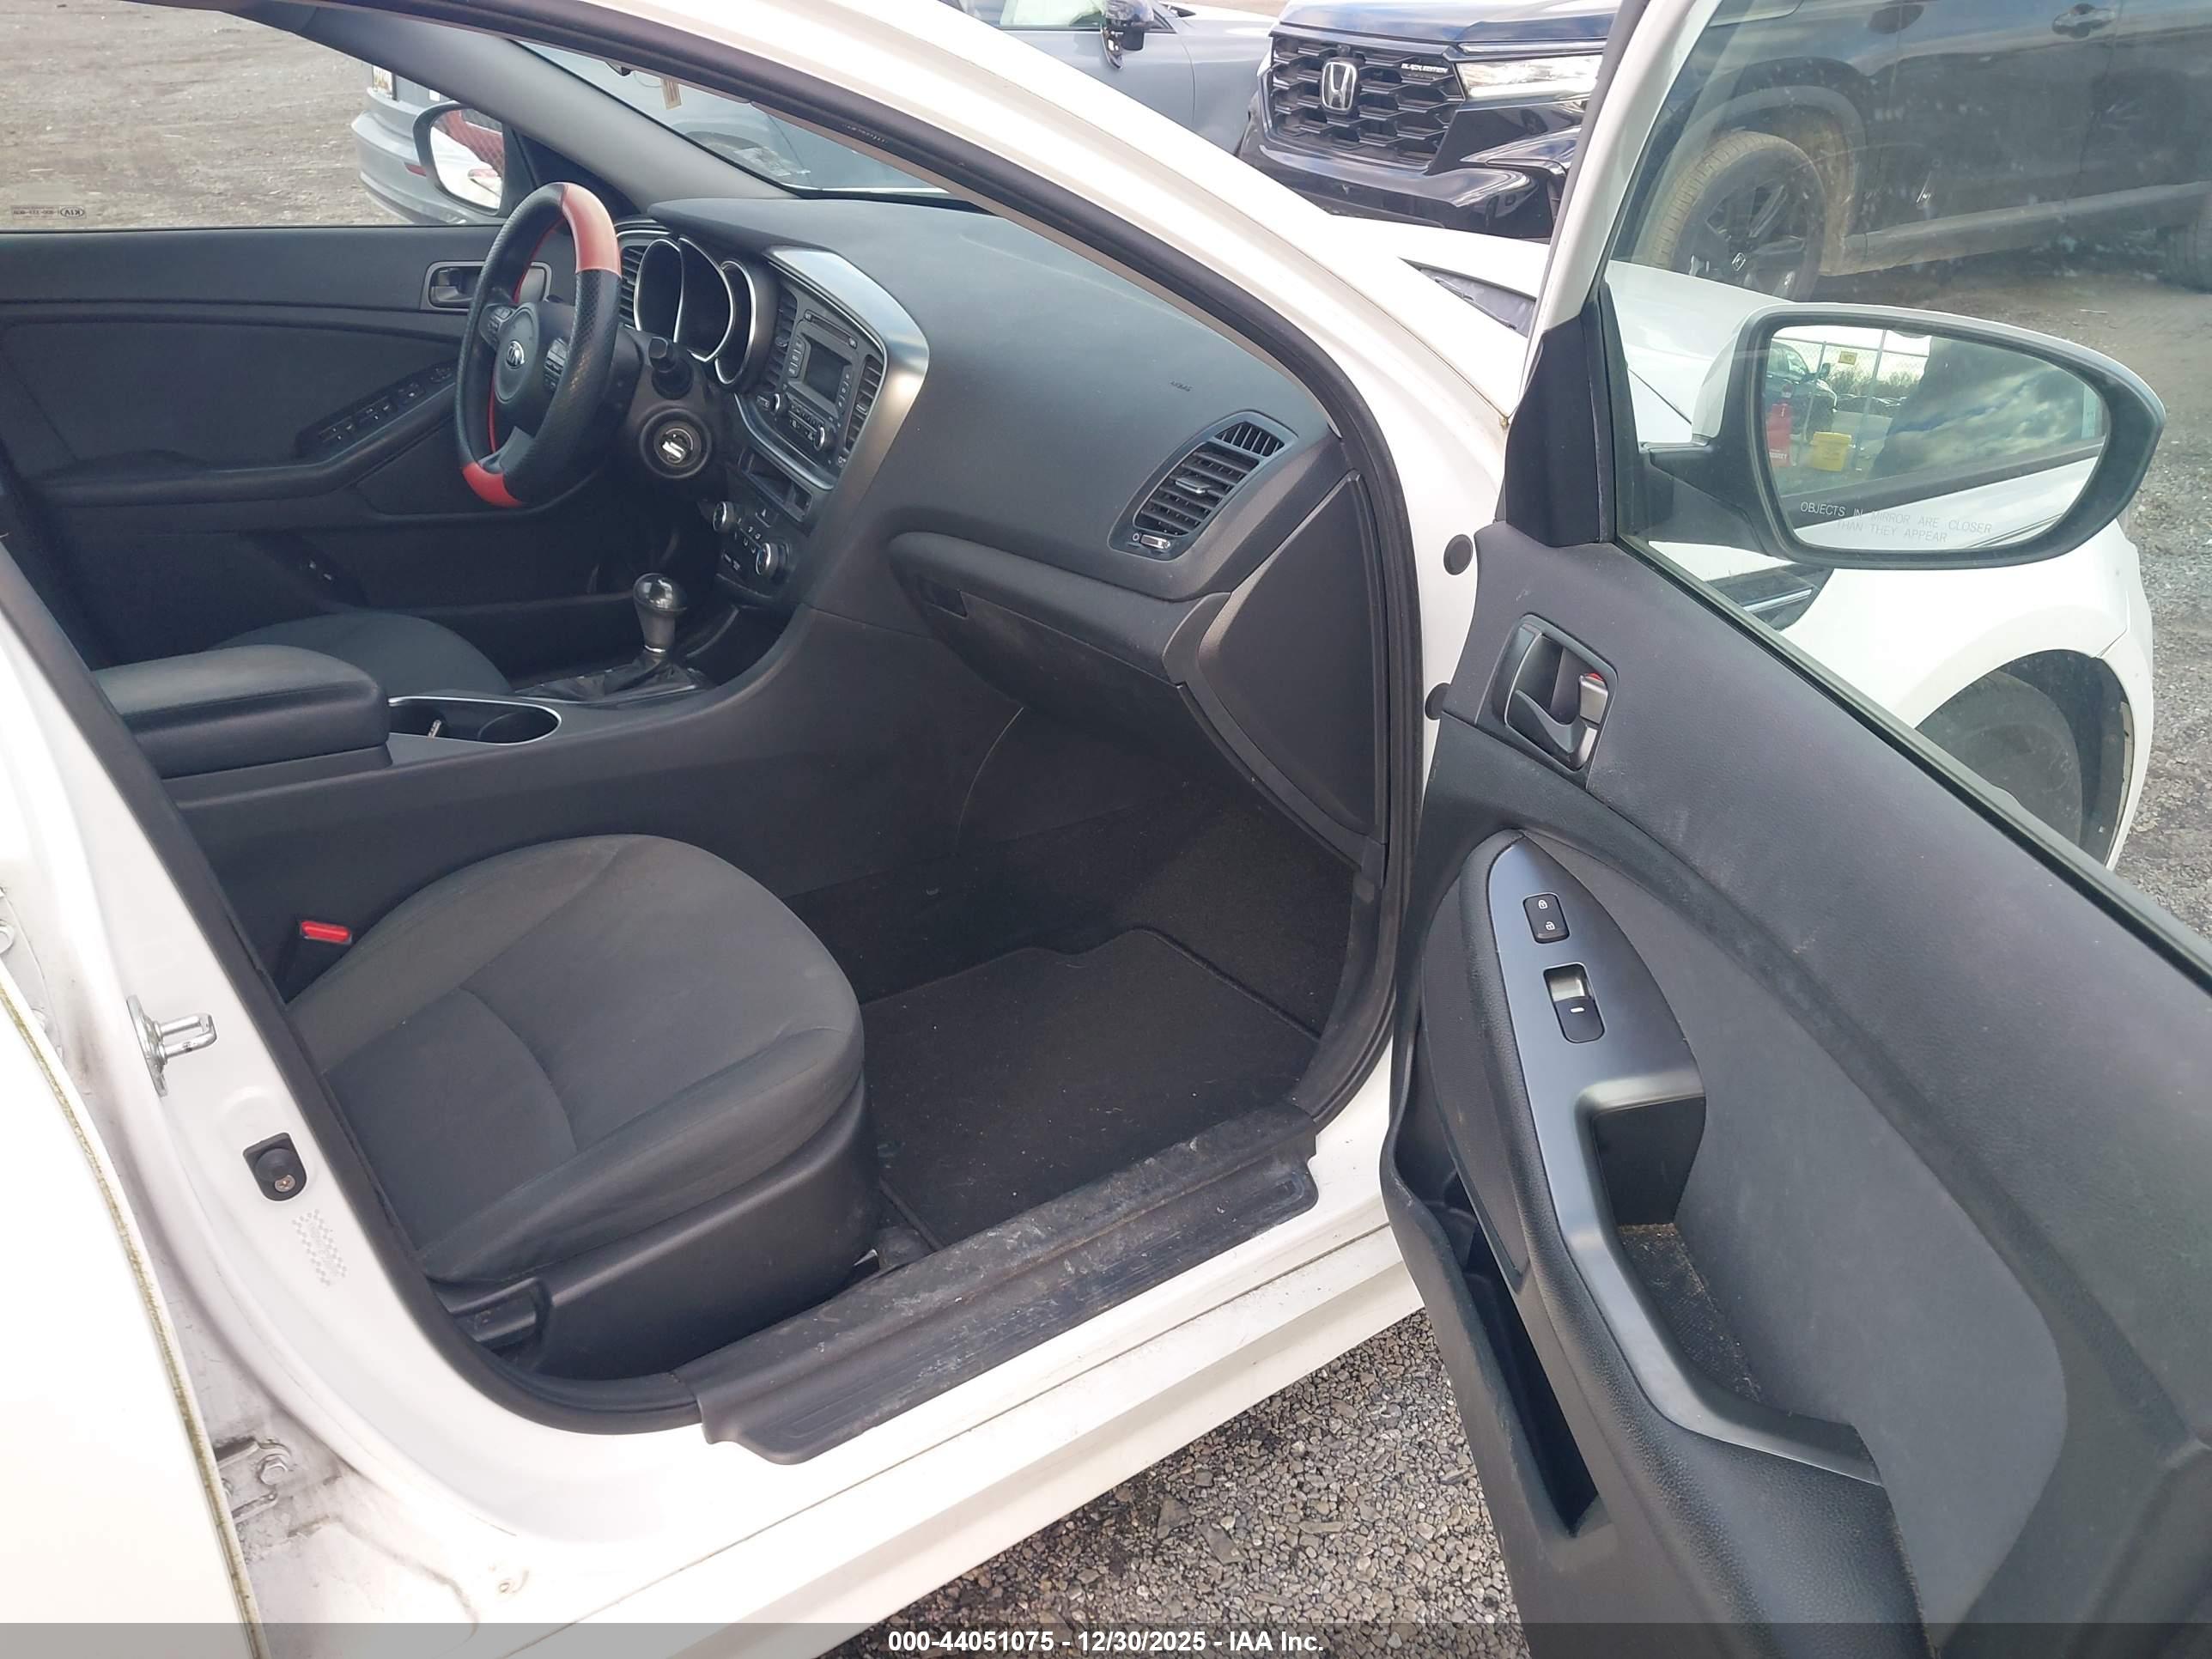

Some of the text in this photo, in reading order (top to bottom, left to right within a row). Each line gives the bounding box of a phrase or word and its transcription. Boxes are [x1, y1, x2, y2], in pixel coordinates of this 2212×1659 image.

[1800, 501, 1993, 534] OBJECTS IN MIRROR ARE CLOSER
[1838, 520, 1948, 544] THAN THEY APPEAR
